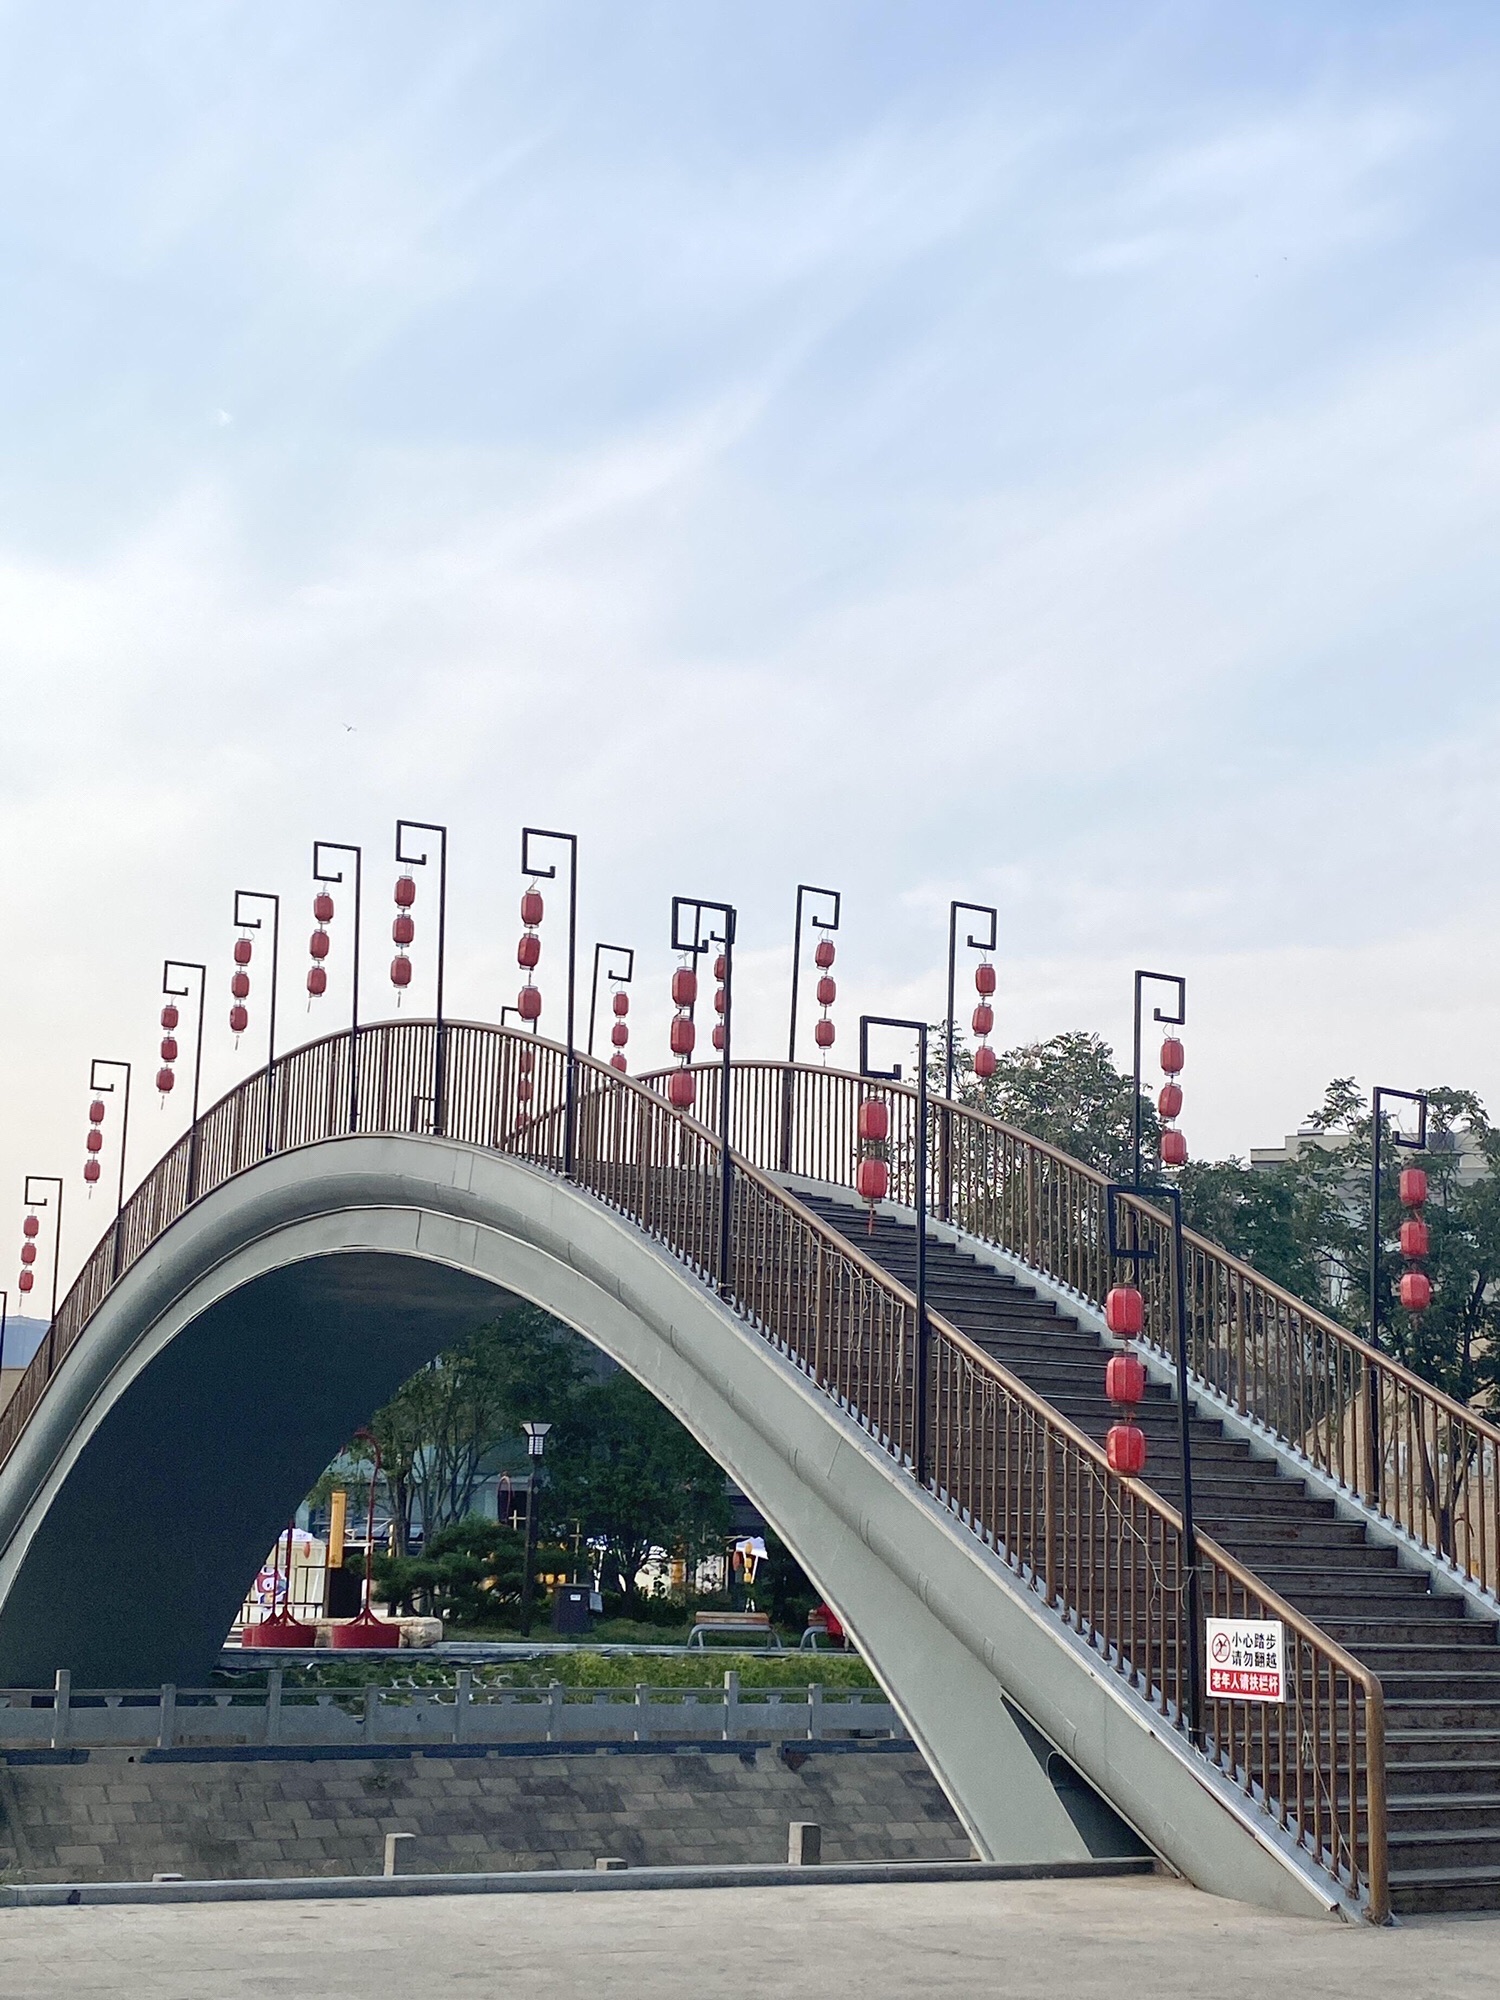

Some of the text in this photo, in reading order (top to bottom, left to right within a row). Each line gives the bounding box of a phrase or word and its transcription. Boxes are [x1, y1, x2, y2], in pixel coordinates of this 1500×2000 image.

[1232, 1631, 1276, 1650] 小心踏步
[1232, 1650, 1277, 1669] 请勿翻越
[1212, 1671, 1278, 1693] 老年人请扶栏杆
